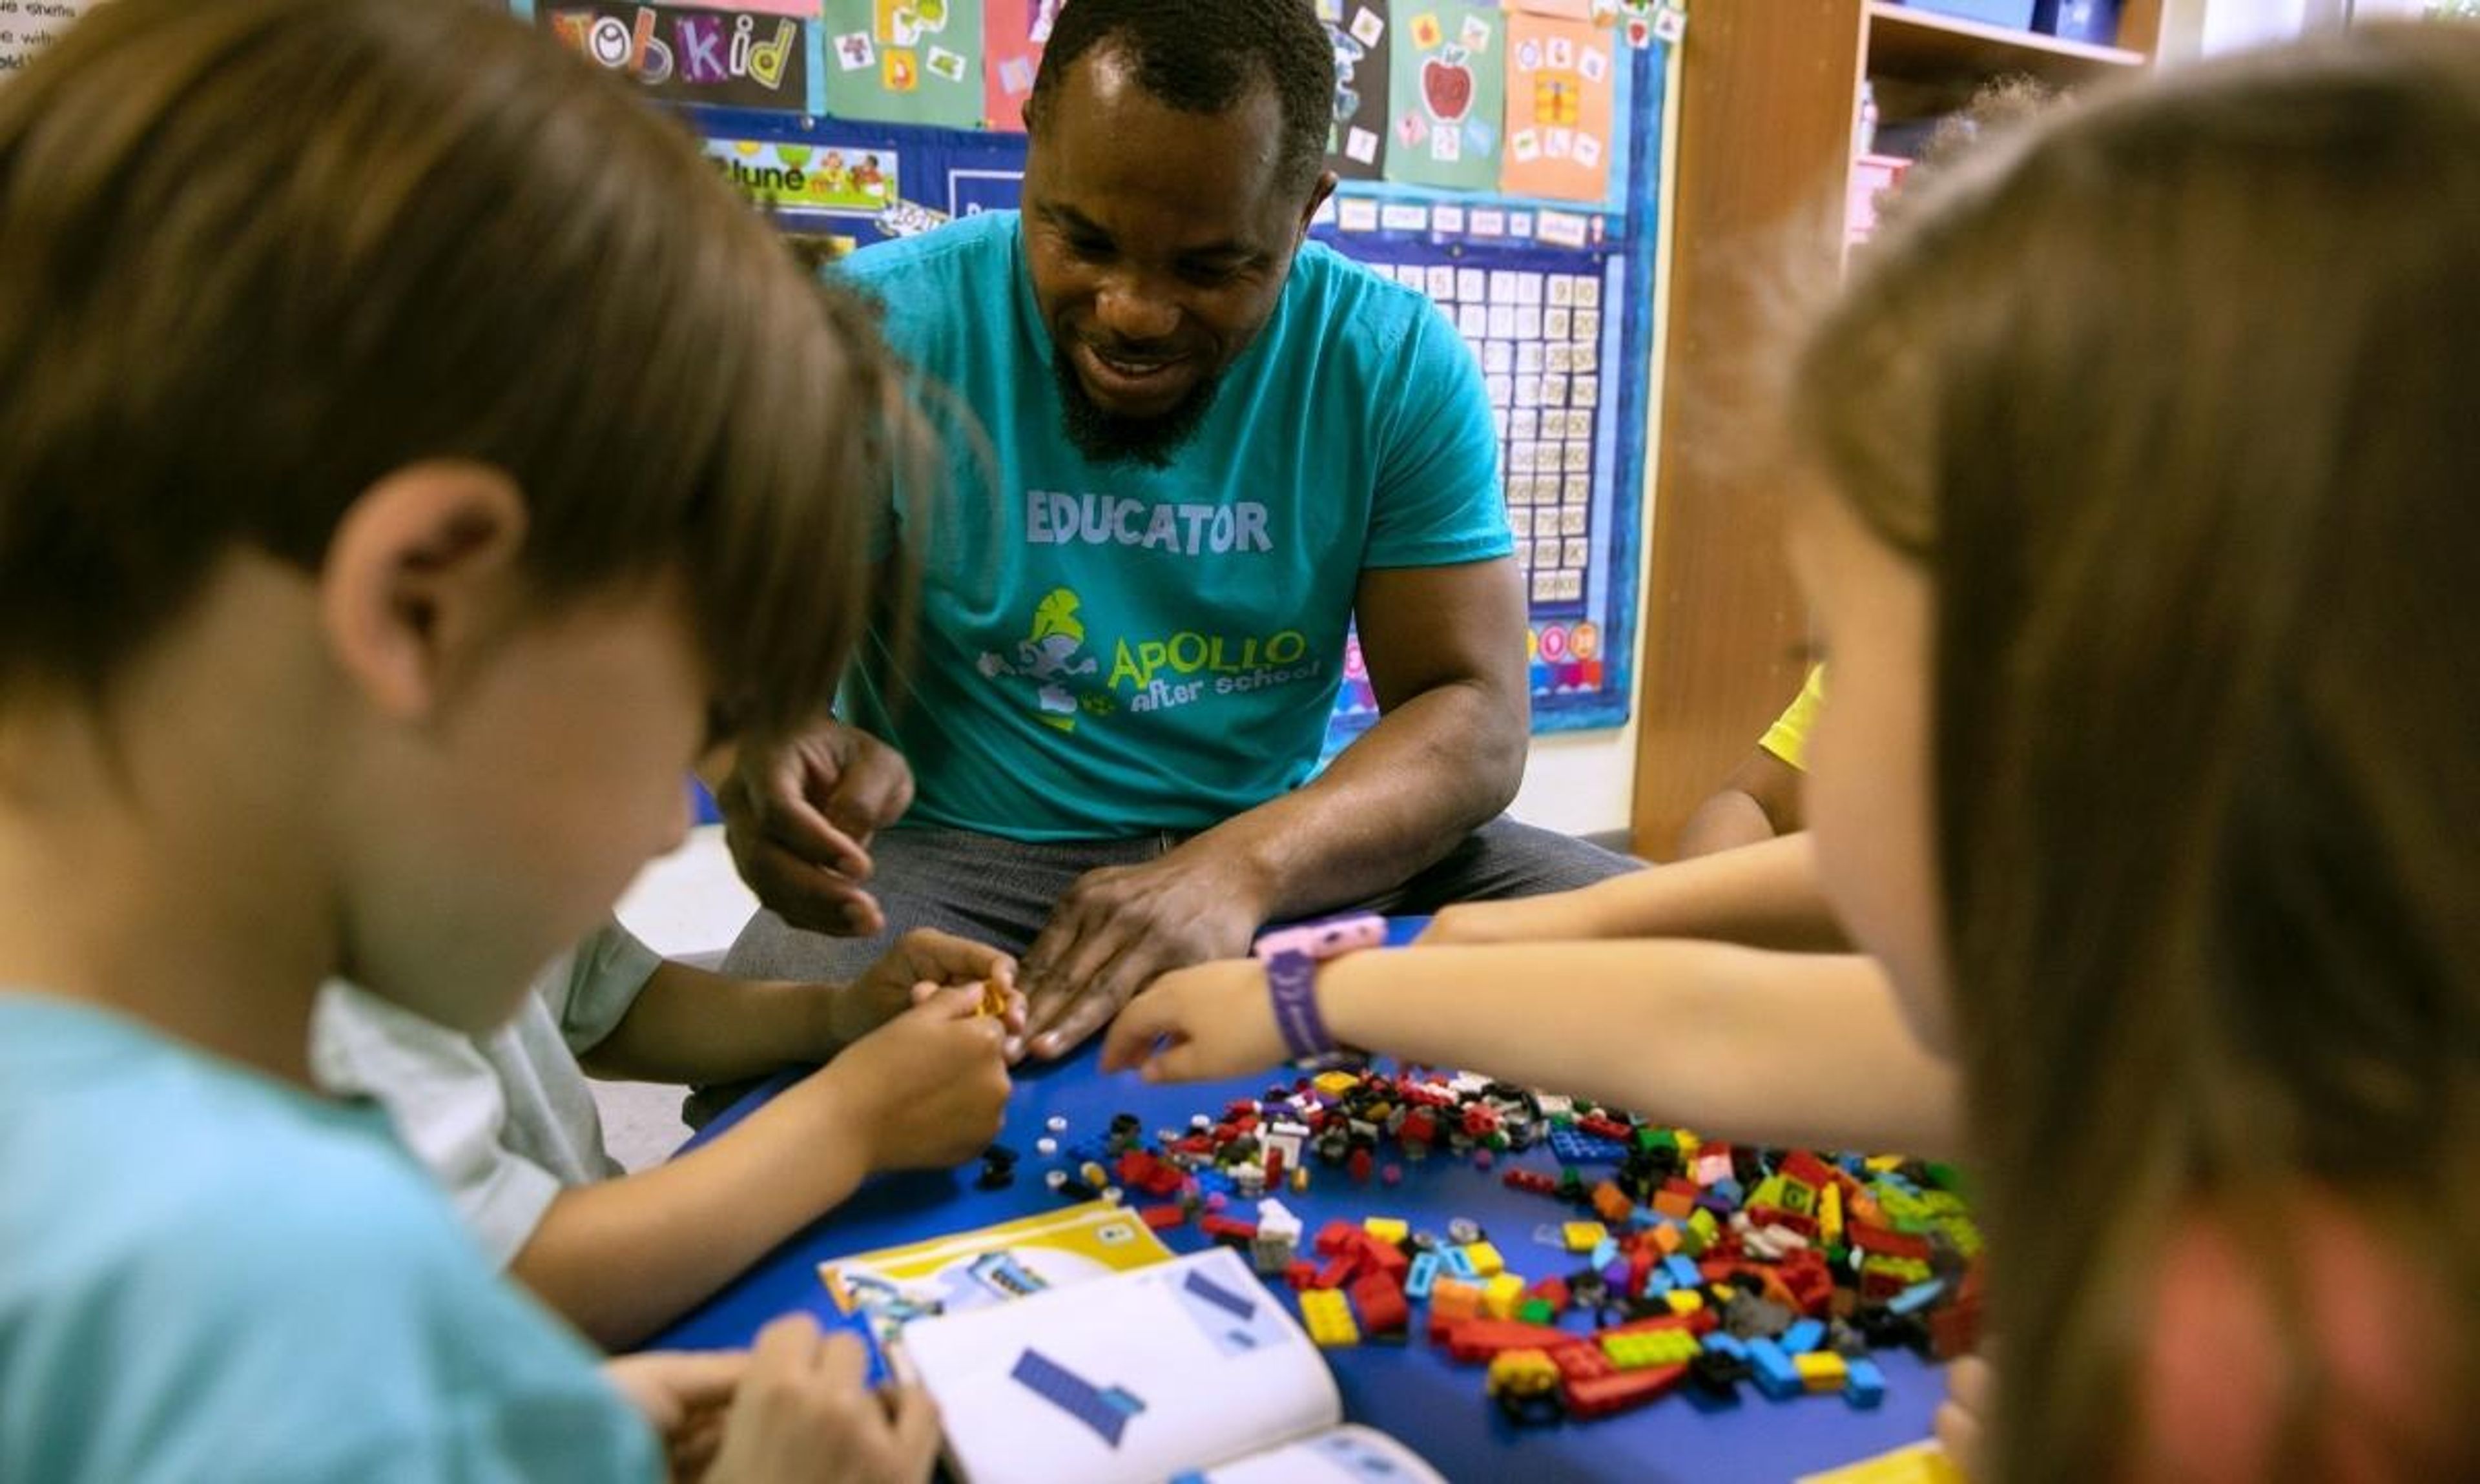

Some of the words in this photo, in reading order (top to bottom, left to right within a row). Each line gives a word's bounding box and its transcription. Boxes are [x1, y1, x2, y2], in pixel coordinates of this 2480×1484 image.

[728, 159, 805, 191] June
[1027, 490, 1272, 555] EDUCATOR
[1108, 630, 1305, 690] APOLLO
[1215, 661, 1321, 694] school
